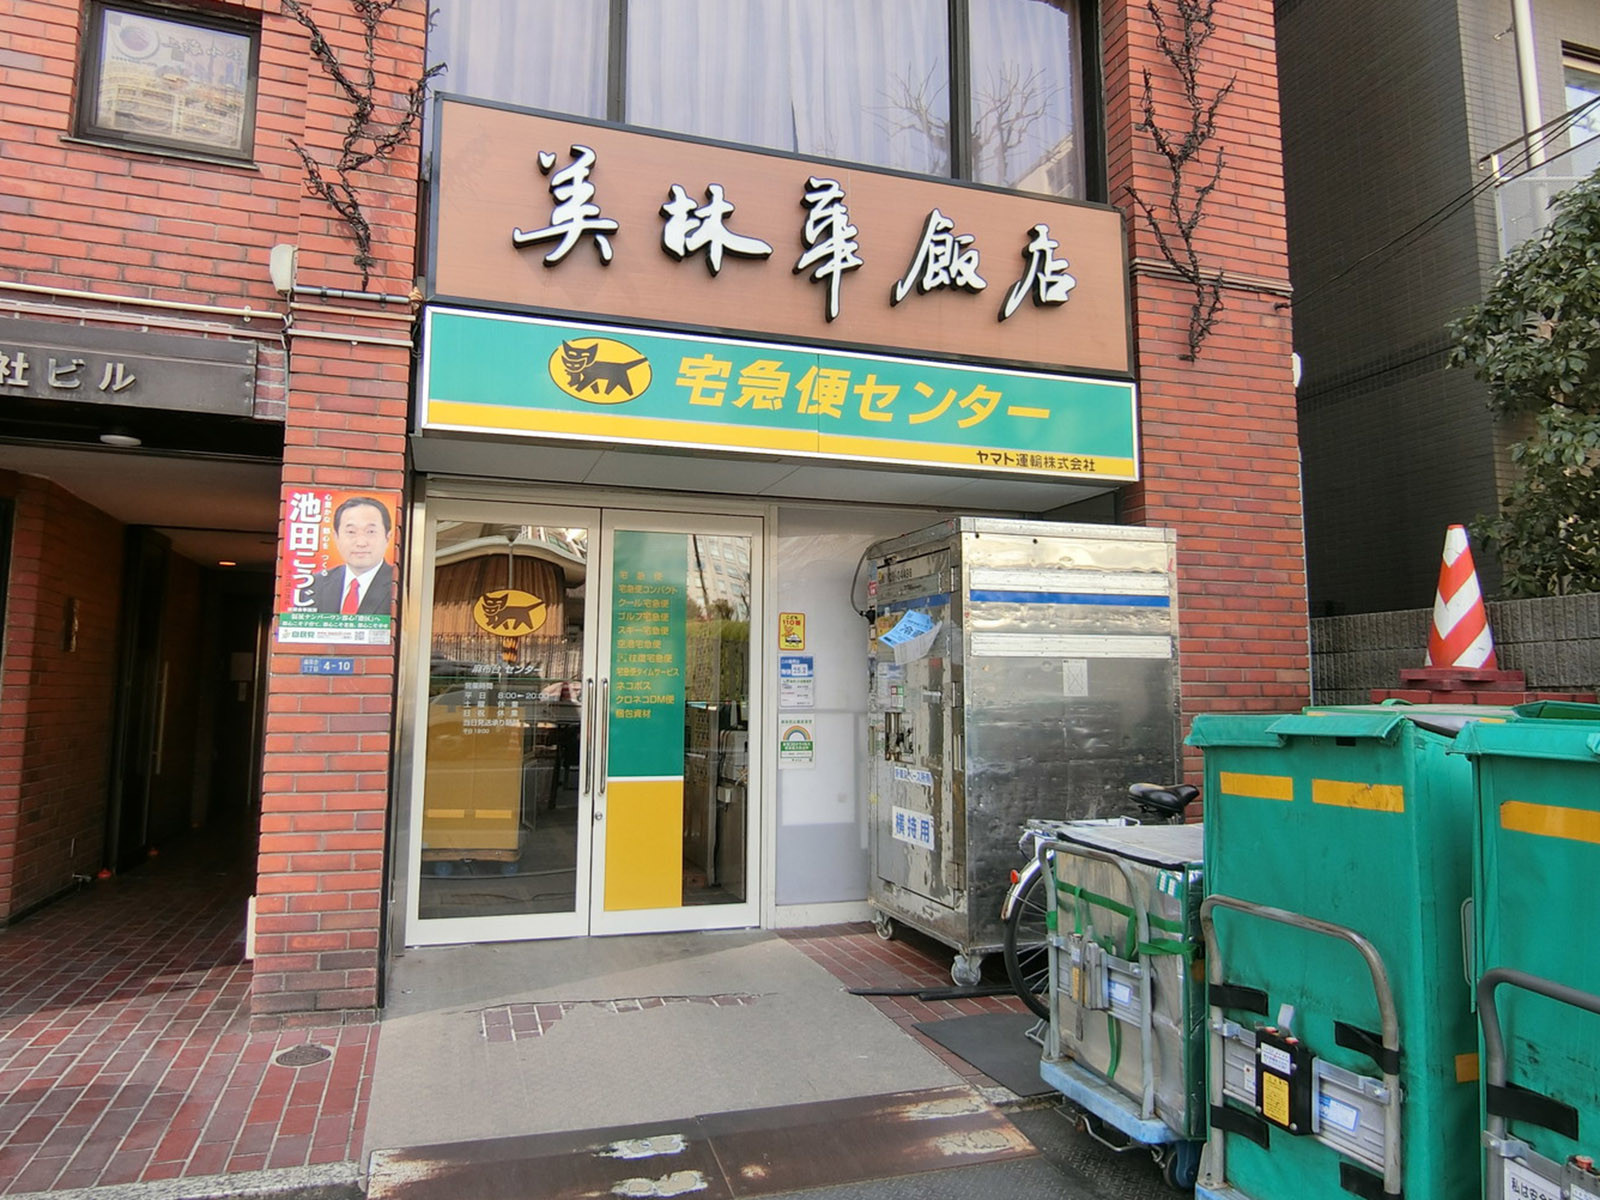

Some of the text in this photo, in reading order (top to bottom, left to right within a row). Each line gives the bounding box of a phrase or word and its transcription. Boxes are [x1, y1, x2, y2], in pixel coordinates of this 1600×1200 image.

[513, 145, 1077, 323] 美林華飯店
[676, 353, 1050, 429] 宅急便センター
[976, 450, 1096, 472] ヤマト運輸株式会社
[289, 492, 322, 607] 池田こうじ
[618, 584, 678, 595] 宅急便コンパクト
[618, 598, 670, 608] クール宅急便
[617, 611, 670, 622] ゴルフ宅急便
[617, 625, 670, 635] スキー宅急便
[323, 661, 351, 671] 4-10
[472, 664, 543, 675] 麻布台 センター
[616, 667, 680, 677] 宅急便タイムサービス
[465, 682, 494, 690] 営業時間
[616, 681, 652, 690] ネコポス
[615, 694, 675, 705] クロネコDM便
[895, 811, 931, 844] 横持用
